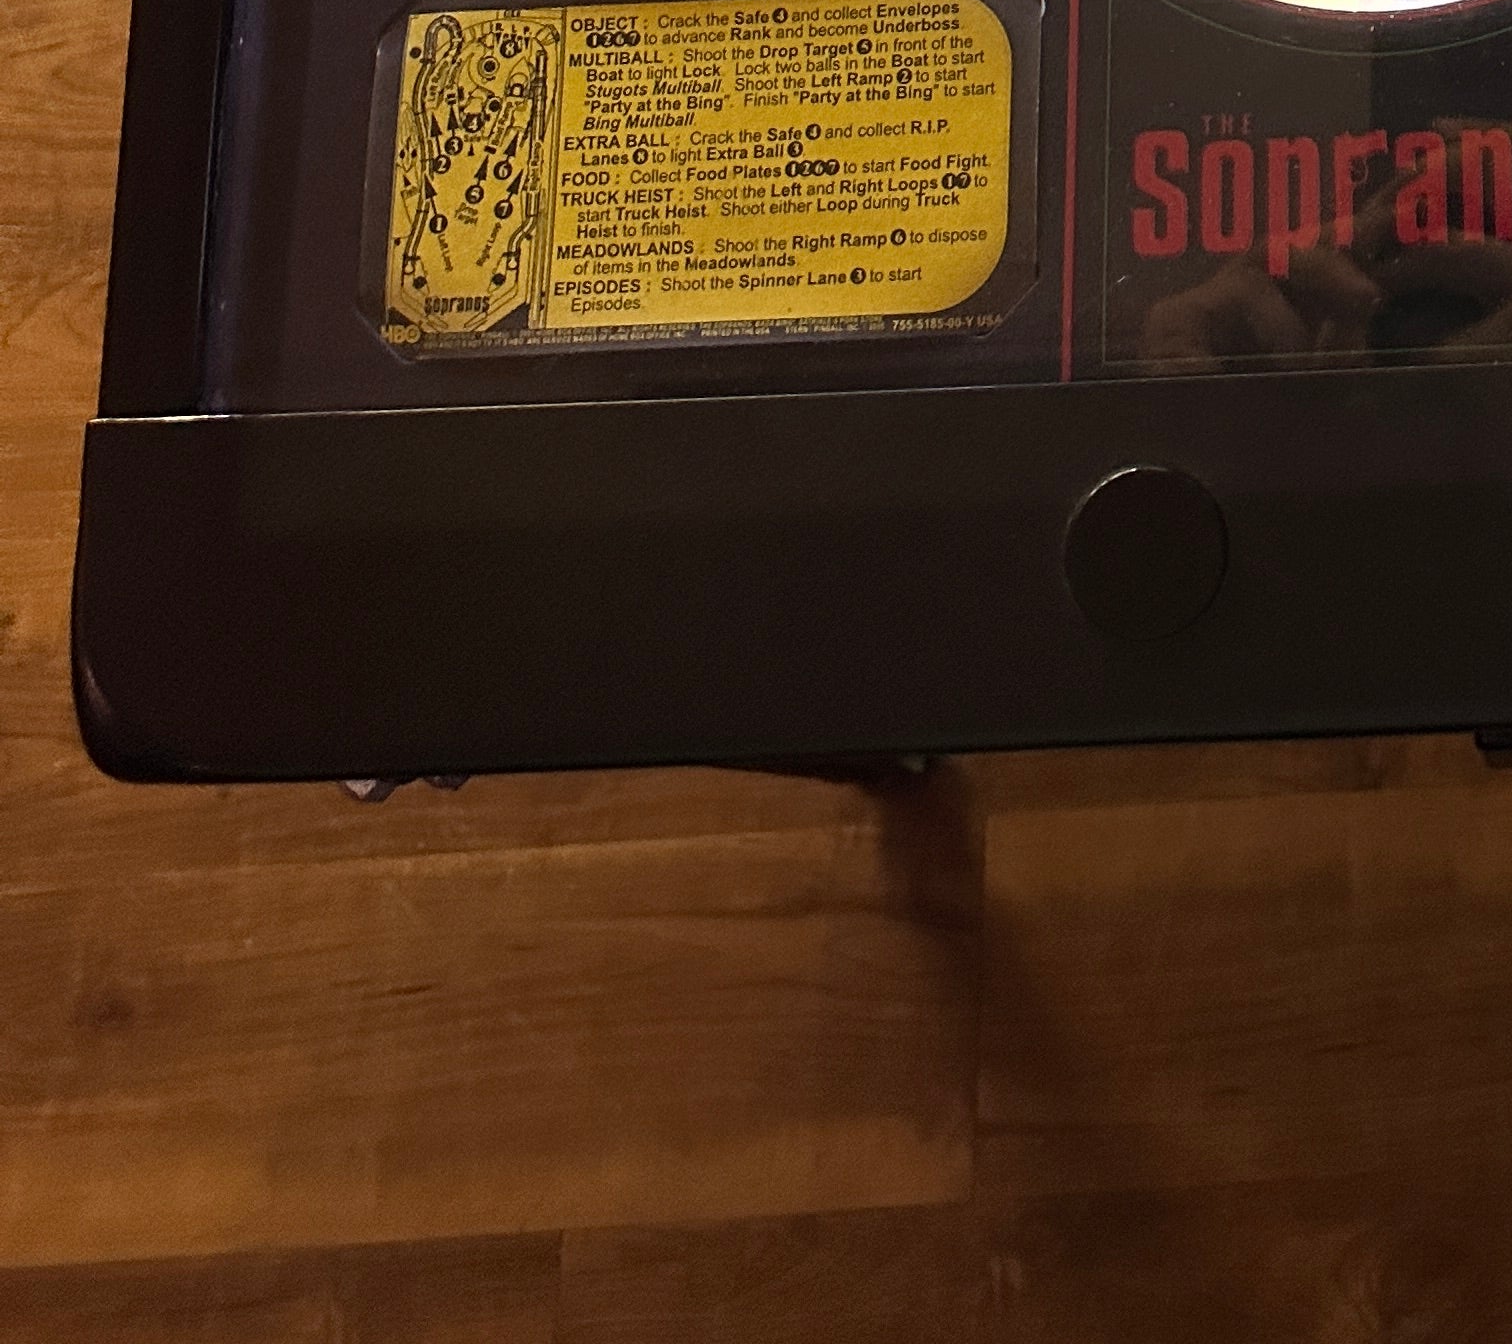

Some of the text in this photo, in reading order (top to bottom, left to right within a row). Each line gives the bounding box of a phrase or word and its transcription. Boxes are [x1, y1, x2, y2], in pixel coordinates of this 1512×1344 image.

[570, 2, 960, 32] OBJECT Crack the Safe and collect Envelopes
[568, 50, 664, 67] MULTIBALL
[584, 99, 633, 115] "Party
[636, 100, 651, 112] at
[656, 97, 682, 111] the
[743, 92, 789, 107] Finish
[793, 90, 841, 106] "Party
[846, 89, 861, 102] at
[865, 87, 891, 101] the
[944, 83, 958, 97] to
[962, 82, 996, 96] start
[1200, 114, 1254, 136] THE
[564, 133, 671, 151] EXTRA BALL
[561, 171, 610, 187] FOOD
[560, 187, 675, 207] TRUCK HEIST
[556, 239, 695, 261] MEADOWLANDS
[553, 278, 641, 296] EPISODES
